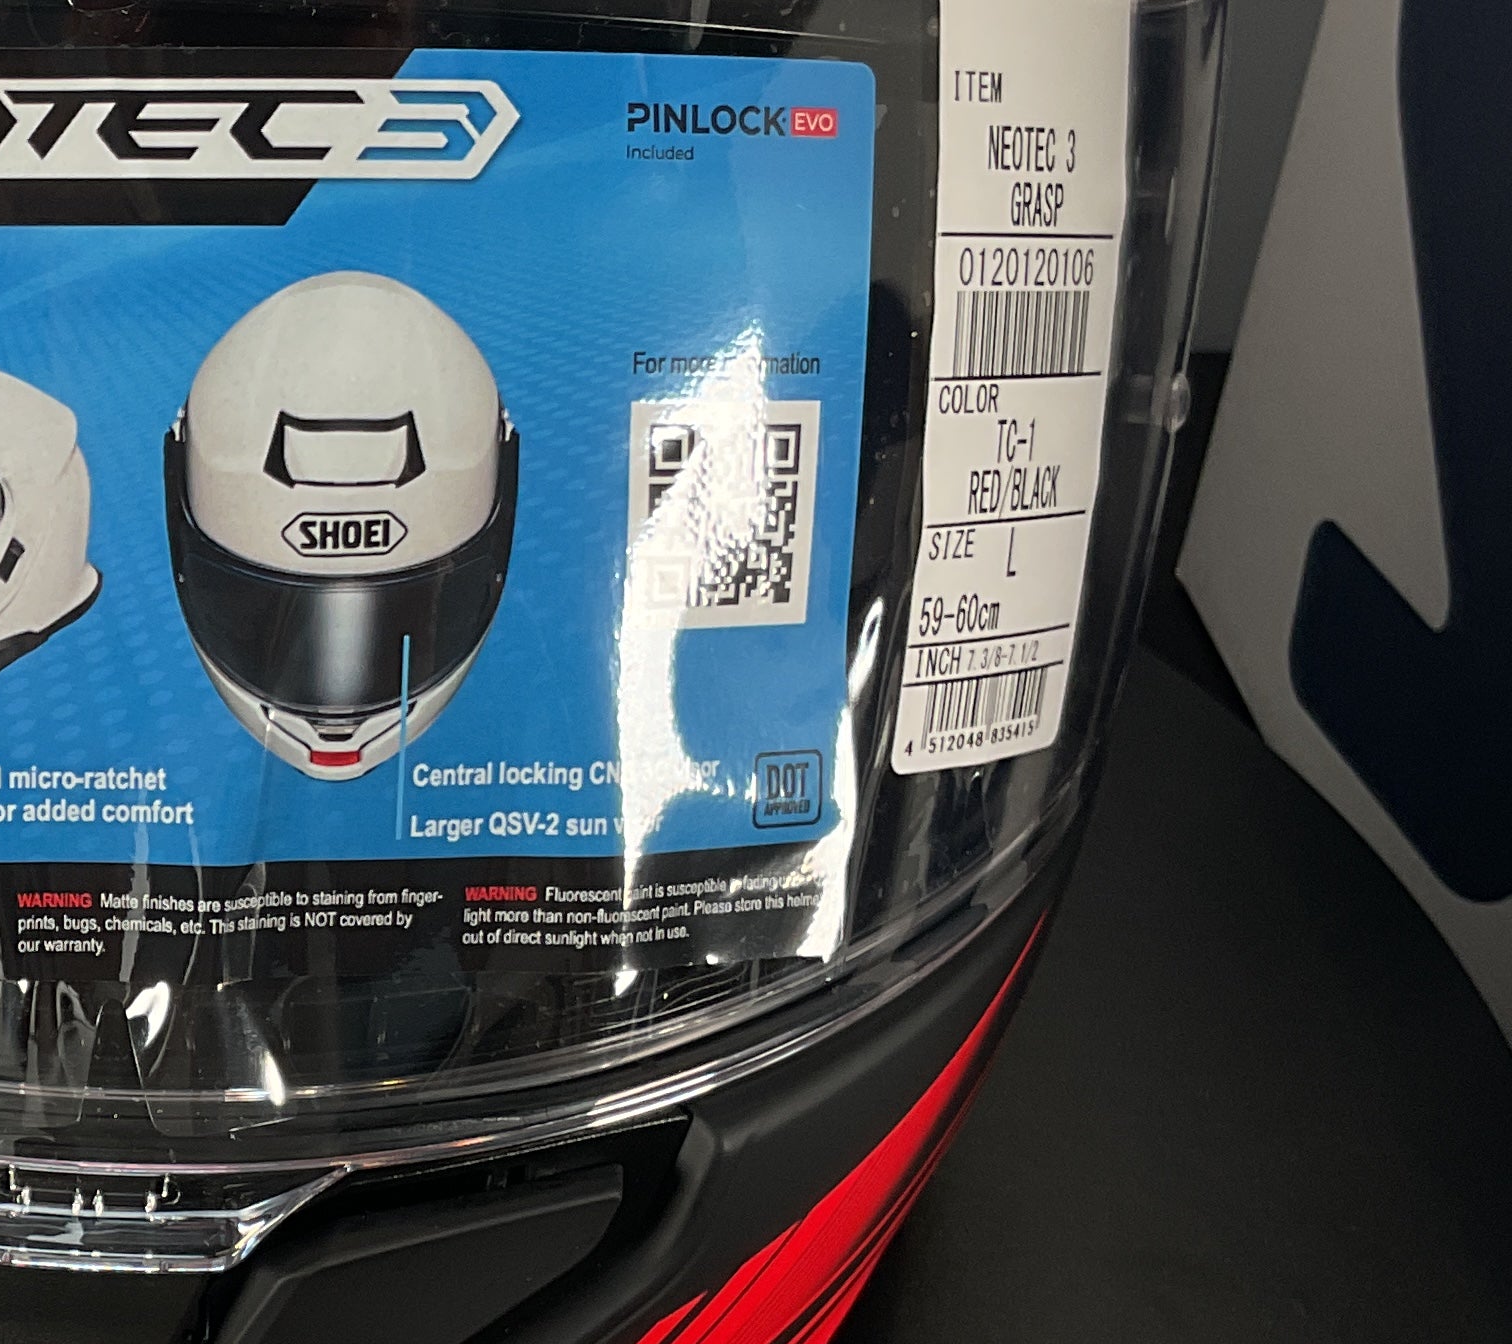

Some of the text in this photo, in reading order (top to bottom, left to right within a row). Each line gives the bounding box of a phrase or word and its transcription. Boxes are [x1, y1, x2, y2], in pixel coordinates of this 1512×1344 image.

[953, 69, 1003, 104] ITEM
[627, 102, 834, 136] PINLOCK EVO
[626, 144, 695, 161] Included
[988, 125, 1077, 173] NEOTEC 3
[1011, 182, 1064, 227] GRASP
[959, 248, 1095, 287] 0120120106
[632, 351, 665, 375] For
[670, 355, 716, 375] more
[939, 384, 999, 414] COLOR
[997, 418, 1036, 463] TC-1
[968, 465, 1061, 518] RED/BLACK
[299, 517, 392, 551] SHOEI
[928, 526, 1016, 577] SIZE L
[919, 594, 1000, 637] 59-60cm
[915, 646, 962, 678] INCH
[904, 740, 914, 757] 4
[928, 731, 984, 754] 512048
[8, 765, 167, 792] micro-ratchet
[412, 760, 493, 789] Central
[499, 759, 584, 791] locking
[766, 762, 809, 799] DOT
[22, 798, 95, 823] added
[101, 799, 194, 825] comfort
[410, 813, 484, 843] Larger
[487, 811, 559, 837] QSV-2
[566, 816, 607, 837] sun
[17, 888, 443, 913] WARNING Matte finishes are susceptible to staining from finger-
[464, 886, 537, 902] WARNING
[545, 885, 623, 903] Fluorescent
[654, 881, 664, 899] is
[666, 877, 727, 898] susceptible
[17, 910, 414, 936] prints, bugs, chemicals, etc. This staining is NOT covered by
[463, 907, 491, 927] light
[494, 910, 529, 924] more
[533, 908, 563, 924] than
[566, 905, 660, 924] non-fluorescent
[693, 900, 733, 916] Please
[734, 897, 762, 914] store
[764, 895, 784, 911] this
[17, 938, 106, 957] our warranty.
[462, 925, 690, 949] out of direct sunlight when not in use.
